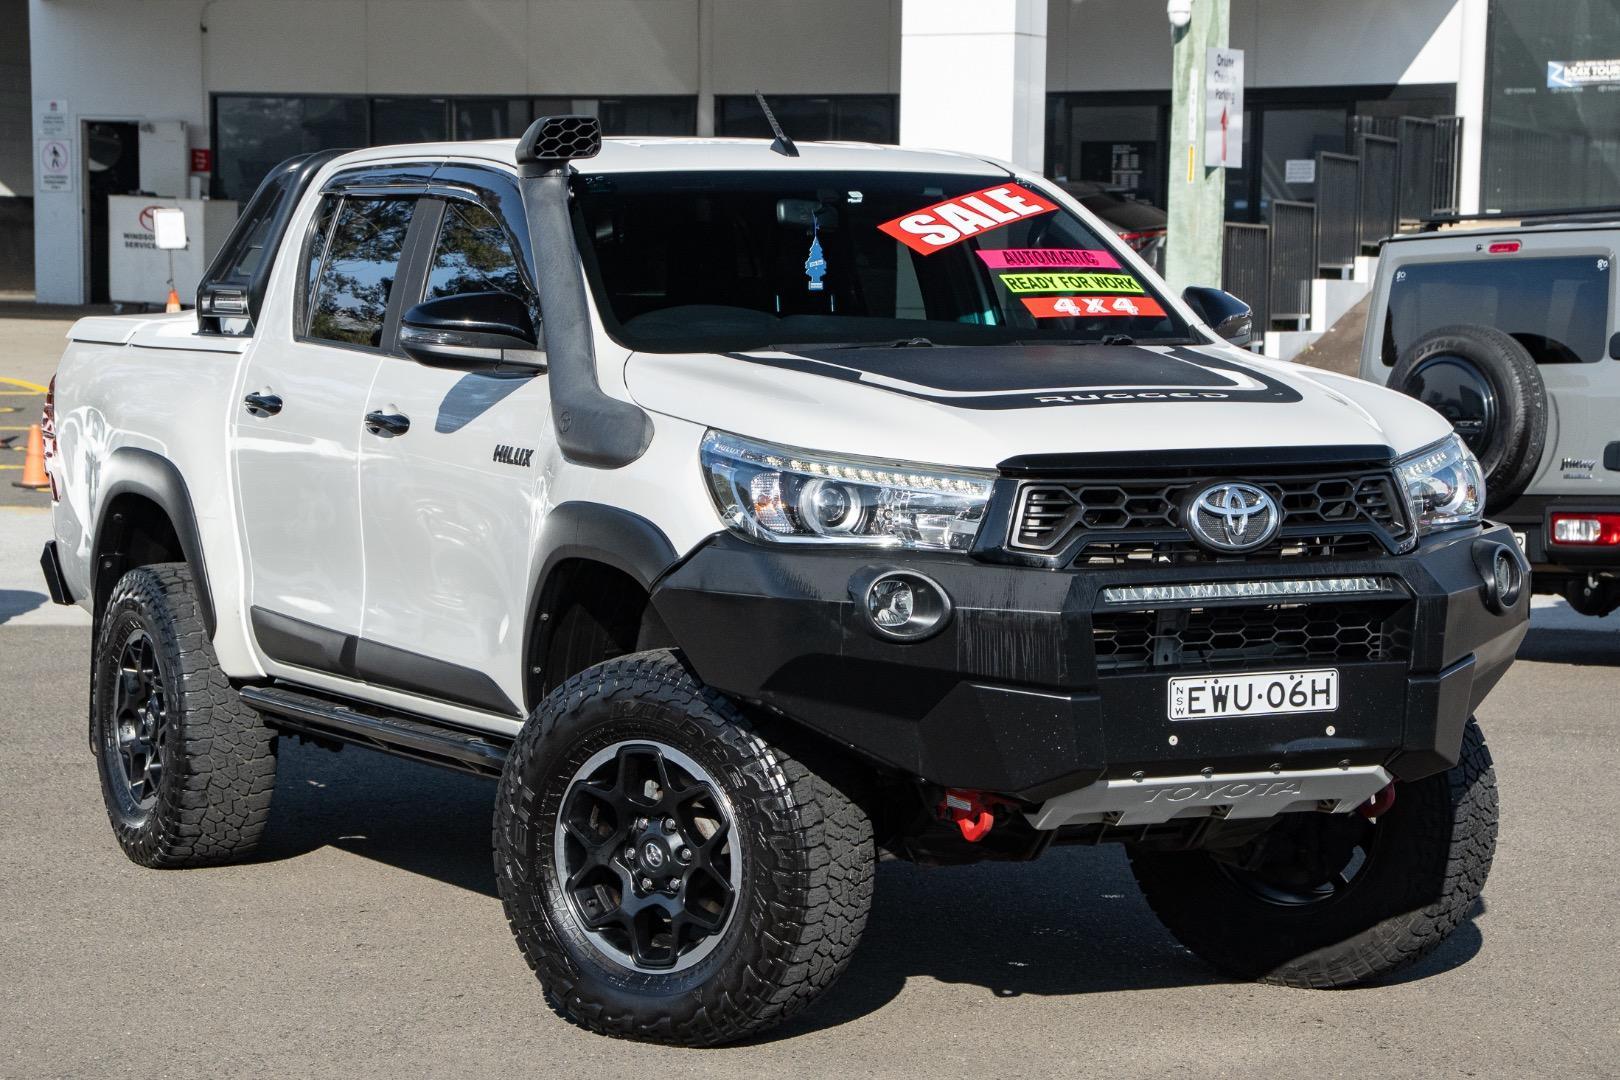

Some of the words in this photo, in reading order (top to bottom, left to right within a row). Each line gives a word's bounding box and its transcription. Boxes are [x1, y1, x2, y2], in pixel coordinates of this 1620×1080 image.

[899, 187, 1045, 246] SALE
[1002, 250, 1099, 266] AUTOMATIC
[1005, 276, 1058, 290] READY
[1057, 275, 1096, 289] FOR
[1089, 276, 1141, 290] WORK
[1034, 392, 1229, 403] RUGGED
[492, 443, 535, 468] HILUX
[1143, 780, 1303, 803] TOYOTA
